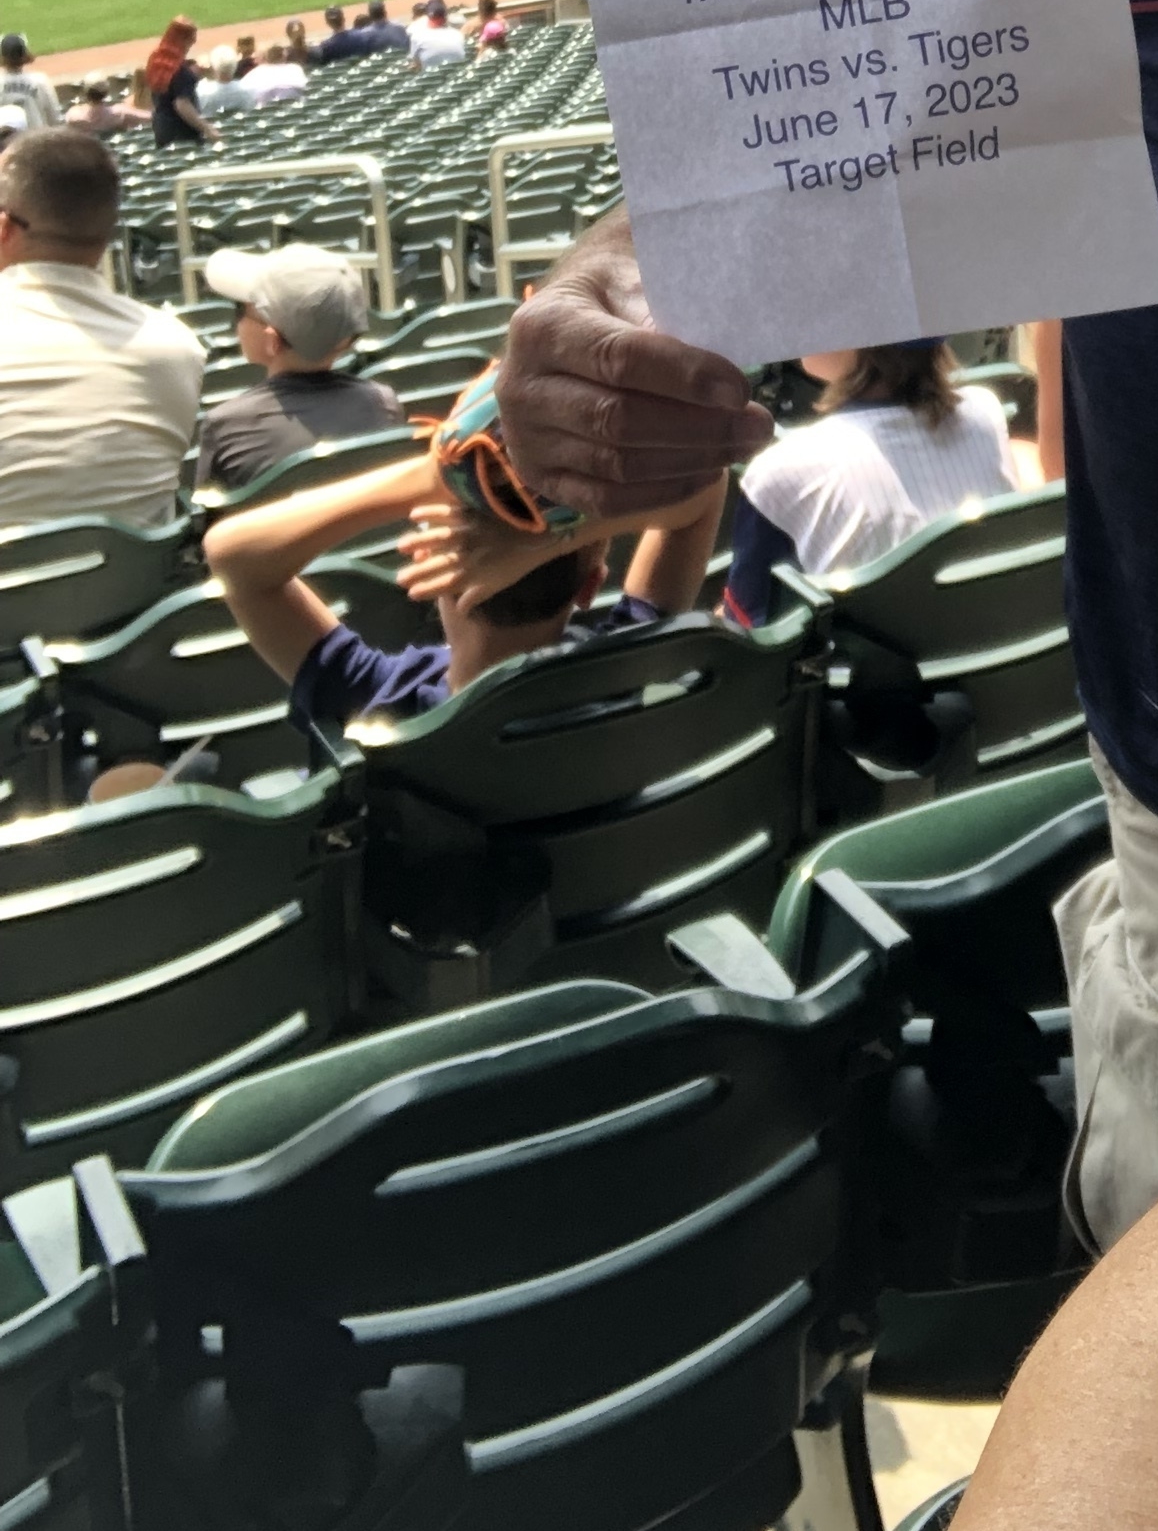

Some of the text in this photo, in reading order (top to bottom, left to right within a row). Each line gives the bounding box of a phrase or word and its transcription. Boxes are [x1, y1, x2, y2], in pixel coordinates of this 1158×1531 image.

[712, 25, 1030, 100] Twins vs. Tigers
[743, 73, 1020, 150] June 17, 2023
[774, 126, 1001, 193] Target Field
